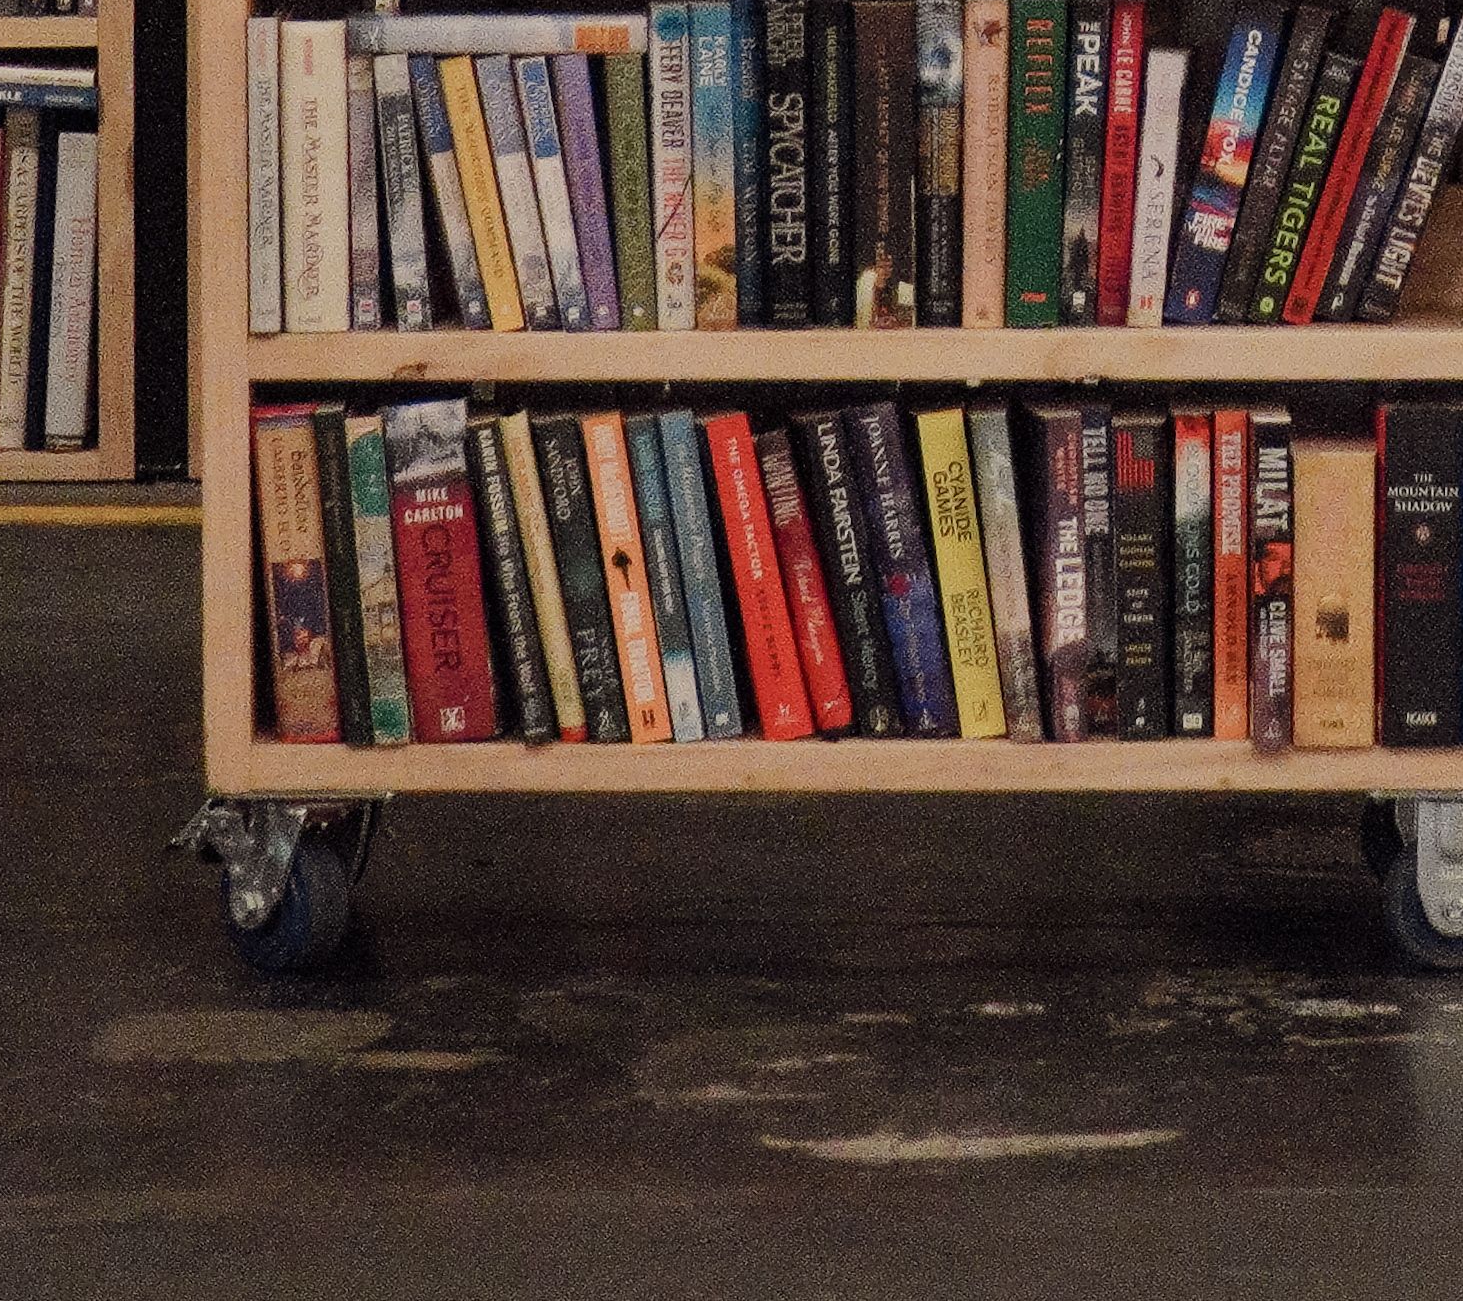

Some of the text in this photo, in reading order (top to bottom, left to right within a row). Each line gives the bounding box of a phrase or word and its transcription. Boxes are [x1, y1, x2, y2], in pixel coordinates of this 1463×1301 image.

[1075, 32, 1101, 115] PEAK
[769, 92, 806, 264] SPYCATCHER
[1264, 94, 1341, 286] REAL TIGERS
[816, 423, 862, 585] LINDA FAIRSTEIN
[1255, 446, 1288, 531] MILAT
[420, 524, 463, 671] CRUISER
